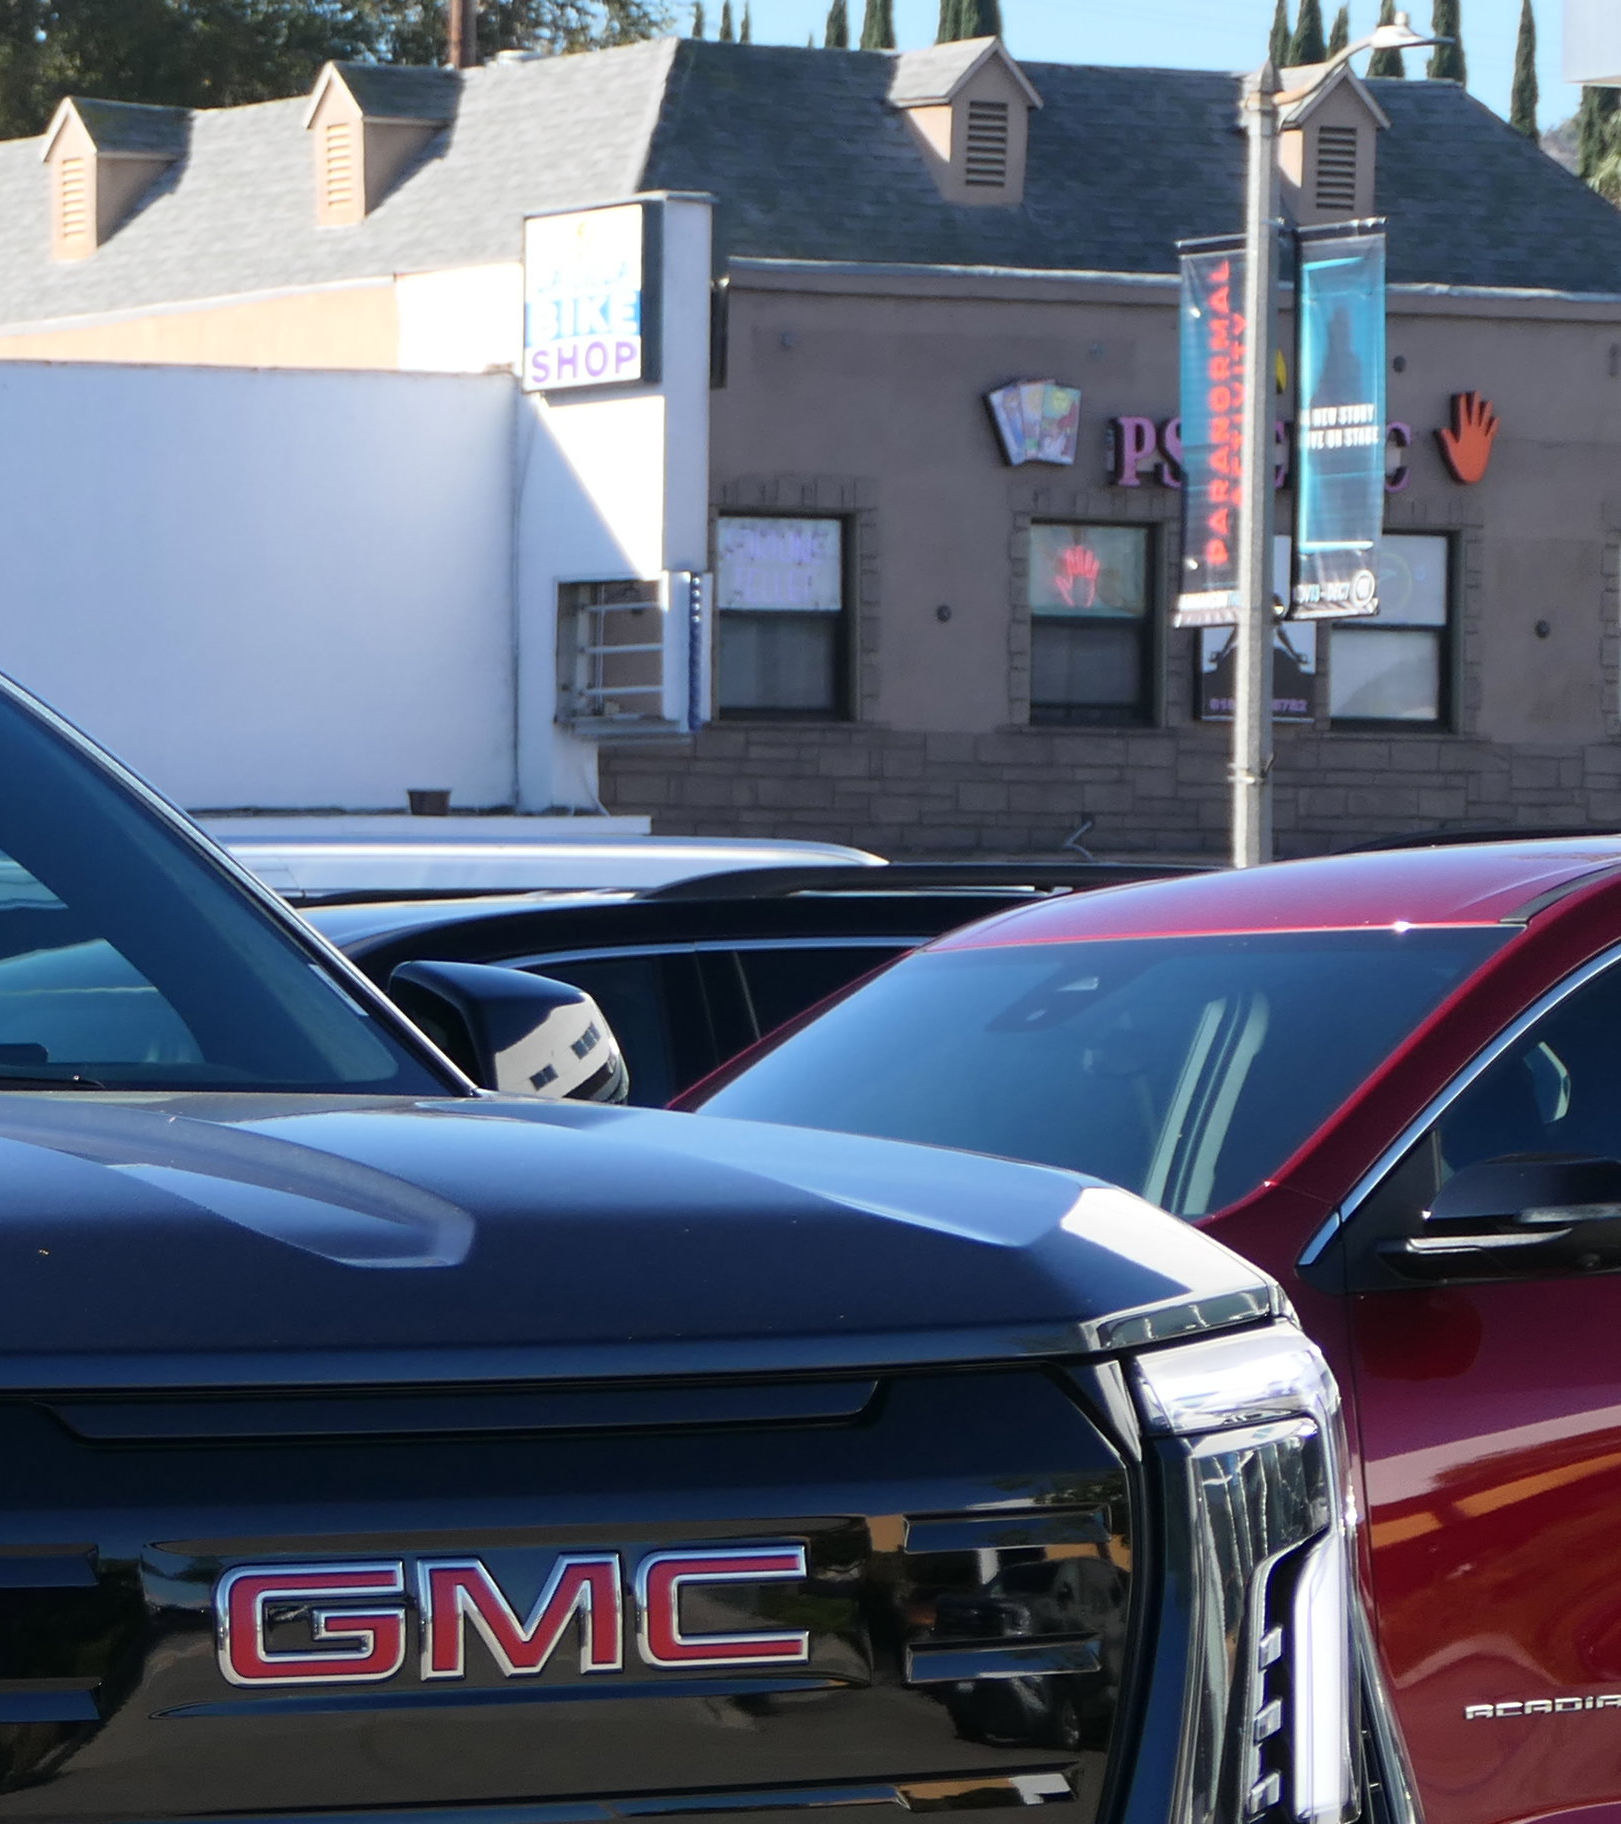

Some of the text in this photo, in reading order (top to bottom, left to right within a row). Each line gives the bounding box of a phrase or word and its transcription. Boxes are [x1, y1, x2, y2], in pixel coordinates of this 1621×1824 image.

[530, 292, 637, 343] BIKE
[531, 341, 638, 383] SHOP
[1205, 260, 1230, 565] PARANORMAL
[1338, 403, 1375, 425] STORY
[1343, 426, 1380, 447] STAGE
[212, 1540, 812, 1688] GMC
[1464, 1694, 1621, 1720] ACADIA
